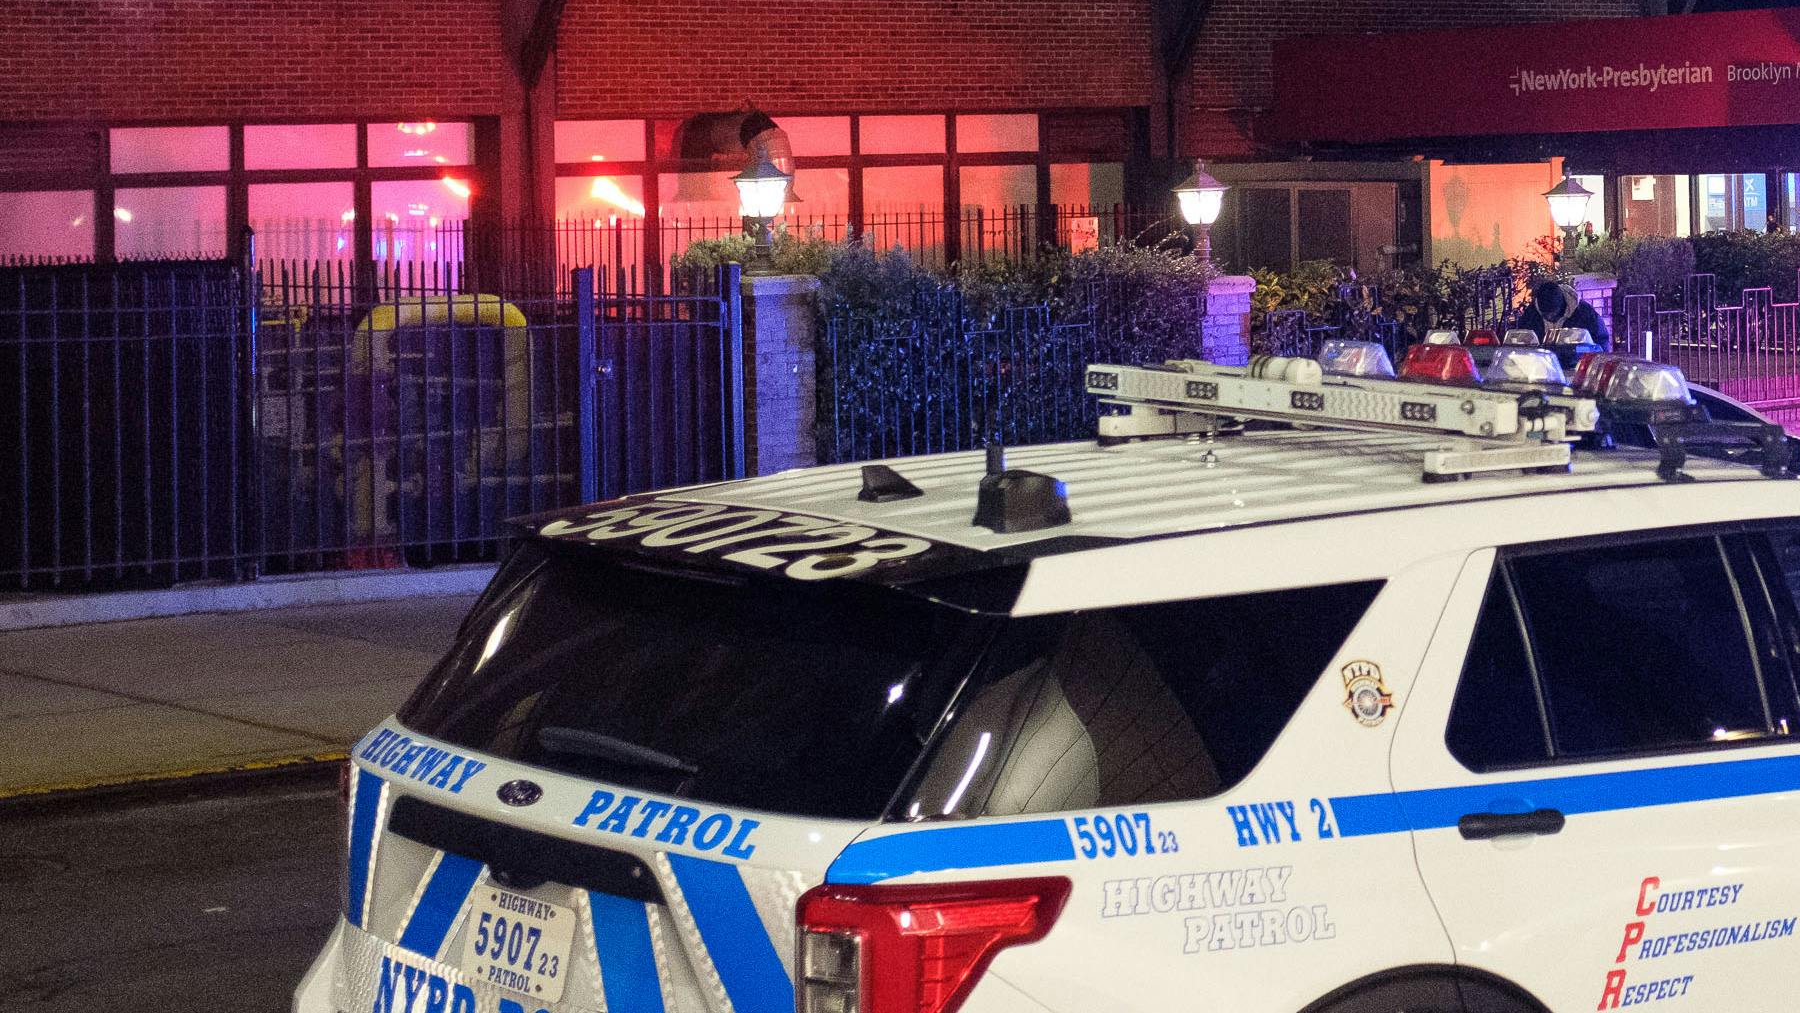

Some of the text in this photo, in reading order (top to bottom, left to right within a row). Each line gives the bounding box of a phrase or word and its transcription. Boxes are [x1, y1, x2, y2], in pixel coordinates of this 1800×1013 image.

[1520, 61, 1714, 93] NewYork-Presbyterian
[1726, 61, 1791, 85] Brooklyn
[539, 500, 932, 581] 590723
[360, 727, 488, 795] HIGHWAY
[572, 789, 762, 861] PATROL
[1226, 800, 1302, 847] HWY
[1309, 797, 1334, 839] 2
[498, 892, 552, 922] HIGHWAY
[1102, 864, 1293, 918] HIGHWAY
[1635, 875, 1745, 917] COURTESY
[1183, 904, 1336, 955] PATROL
[1615, 917, 1798, 964] PROFESSIONALISM
[487, 964, 531, 994] PATROL
[1597, 968, 1695, 1011] RESPECT
